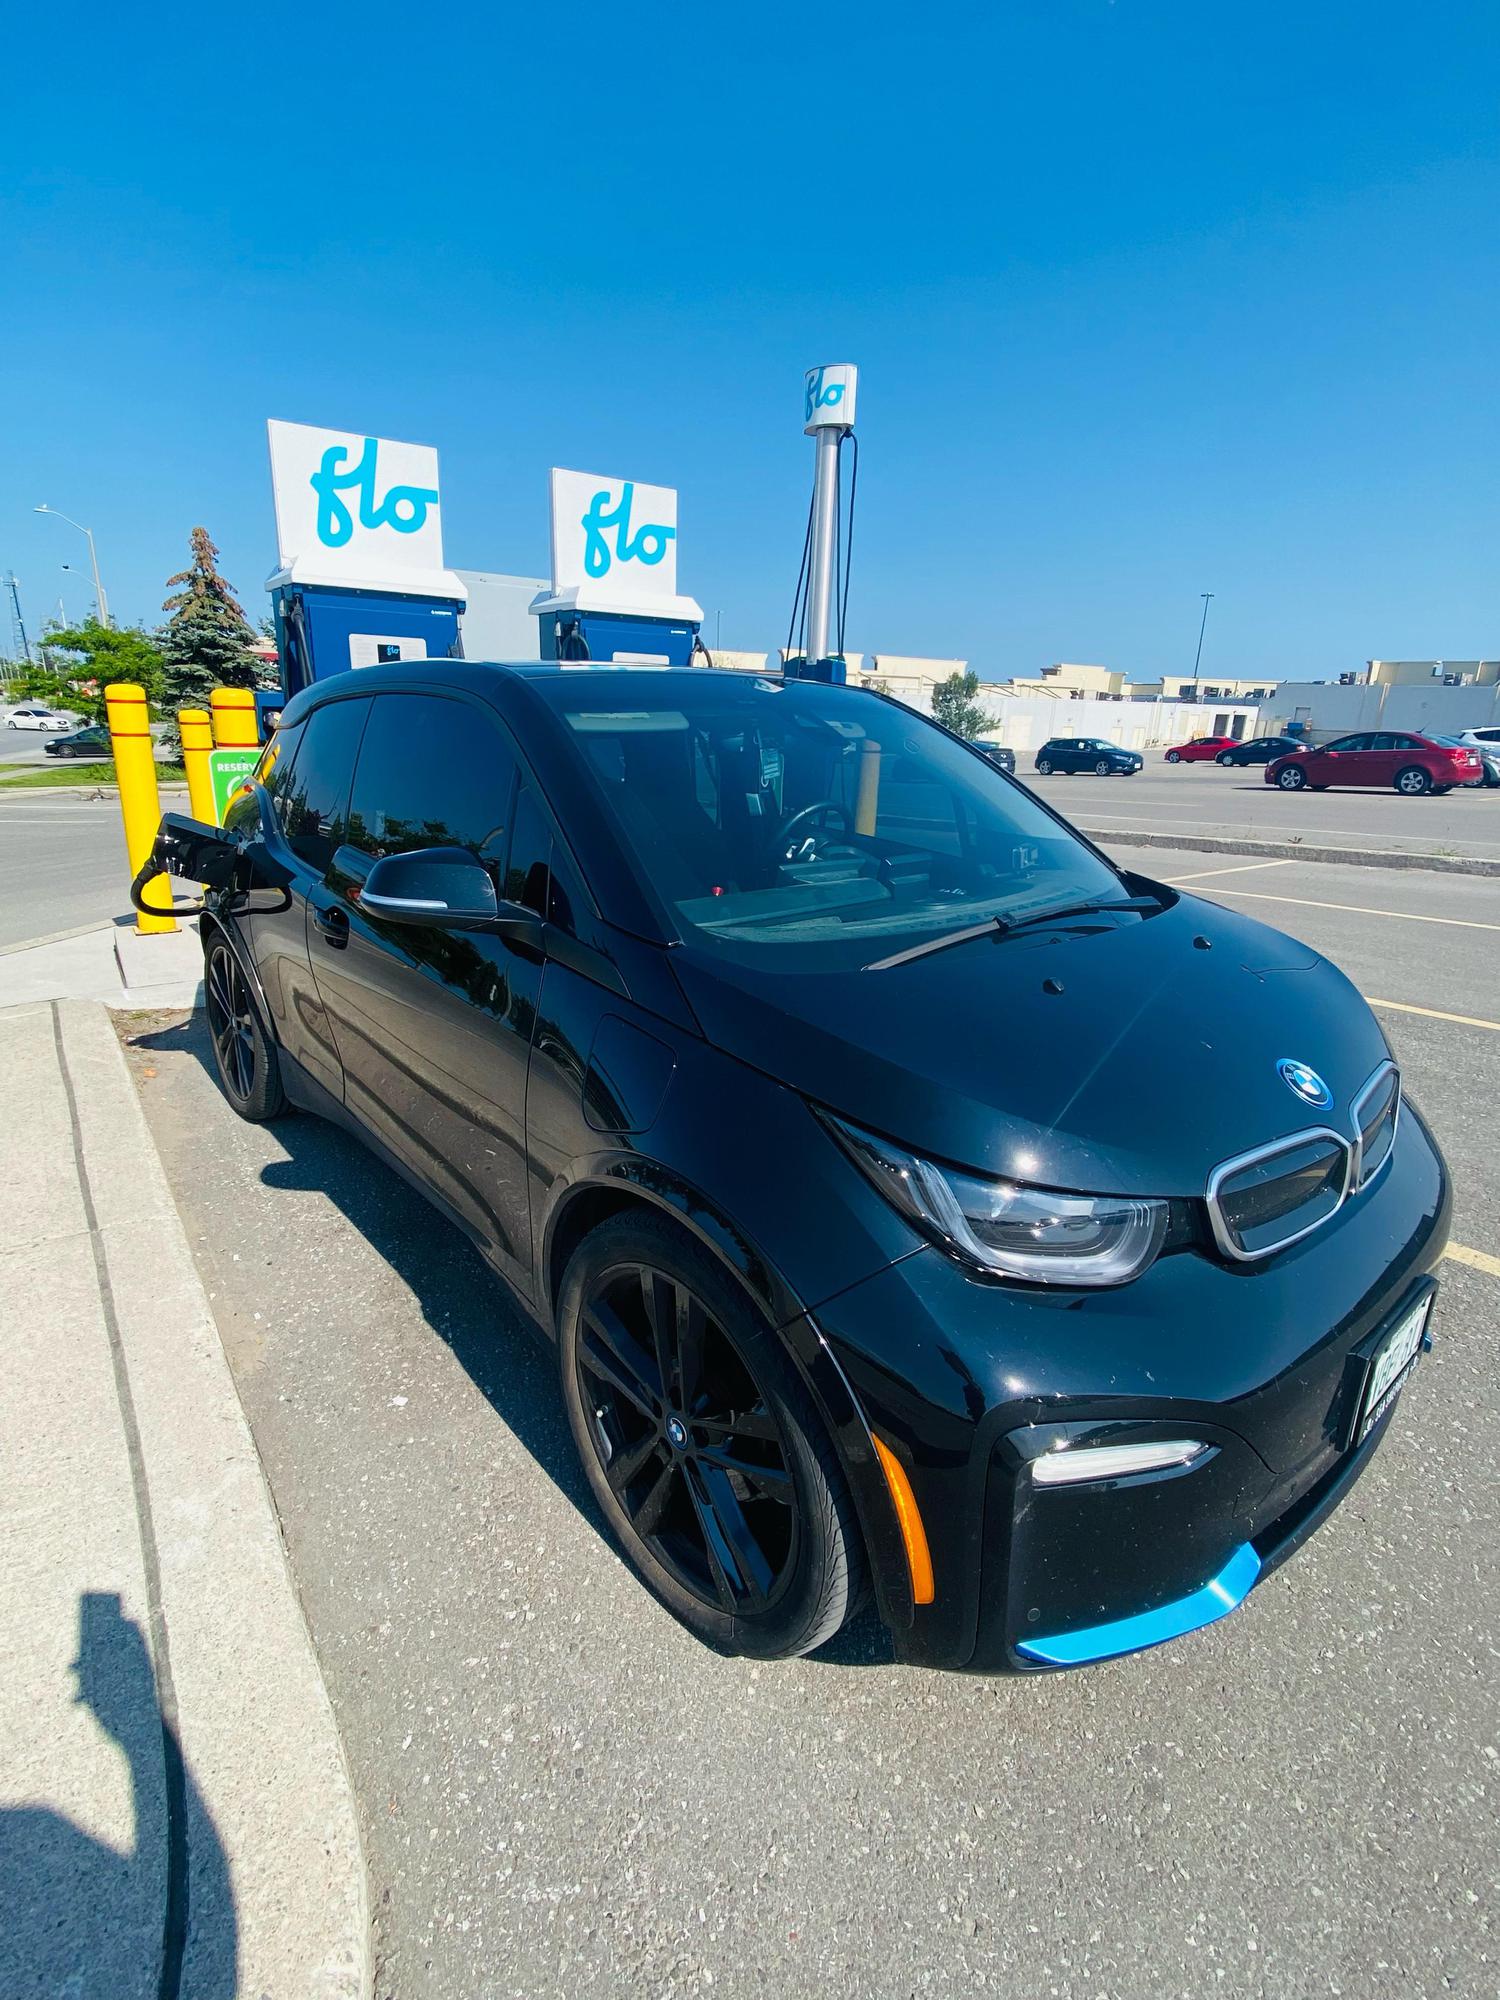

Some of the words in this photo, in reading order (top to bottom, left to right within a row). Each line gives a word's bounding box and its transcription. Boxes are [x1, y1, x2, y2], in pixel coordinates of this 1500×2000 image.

[805, 366, 846, 421] flo
[310, 437, 438, 548] flo
[581, 482, 676, 578] flo
[386, 645, 400, 656] flo
[217, 763, 257, 772] RESERV
